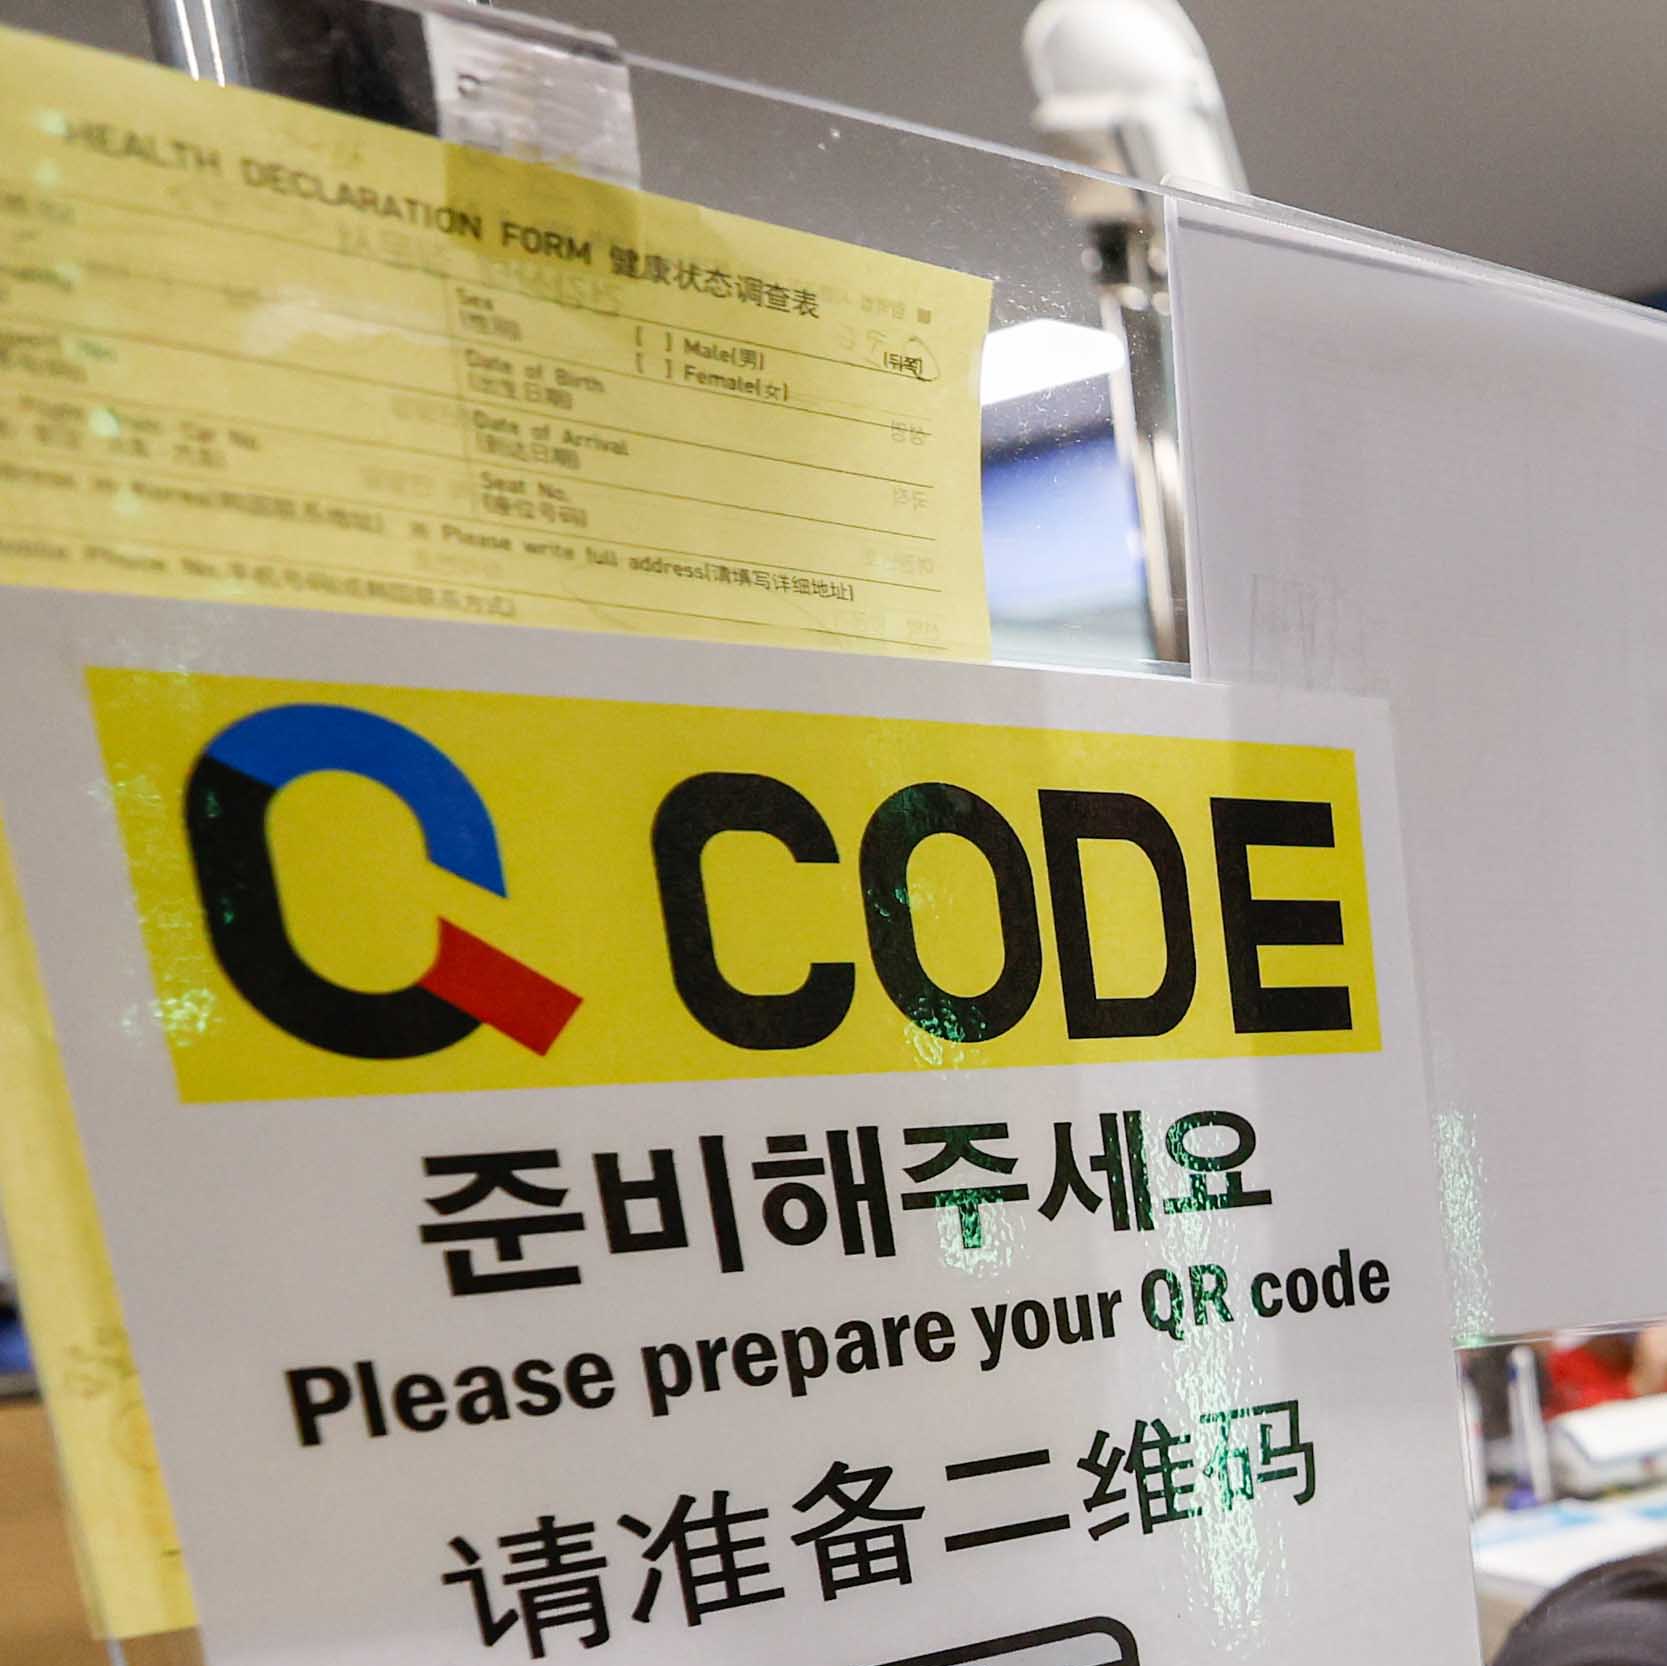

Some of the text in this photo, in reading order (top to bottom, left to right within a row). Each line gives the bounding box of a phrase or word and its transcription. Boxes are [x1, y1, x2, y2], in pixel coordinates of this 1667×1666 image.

[239, 156, 482, 242] DECLARATION
[501, 220, 592, 265] FORM
[609, 244, 820, 320] 健康状态调查表
[184, 701, 1354, 1061] Q CODE
[414, 1107, 1276, 1299] 준비해주세요
[282, 1245, 1393, 1449] Please prepare your QR code
[441, 1397, 1320, 1664] 请准备二维码
